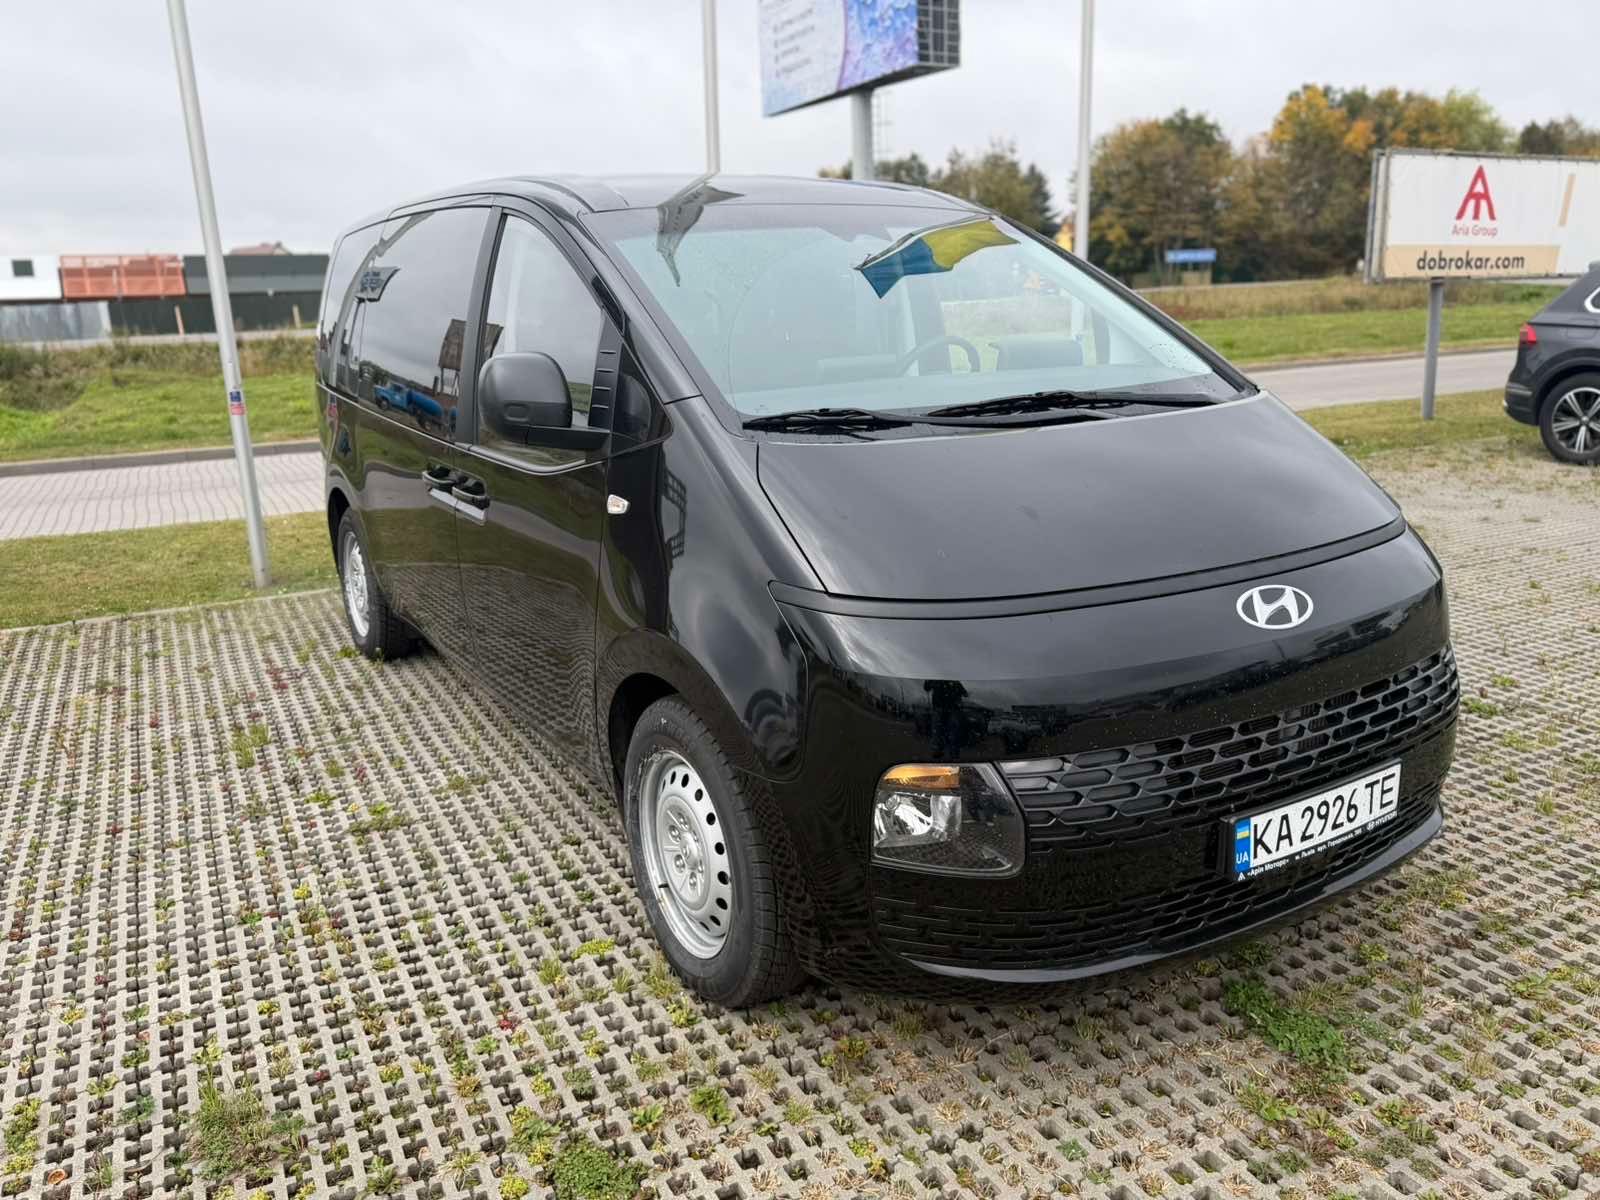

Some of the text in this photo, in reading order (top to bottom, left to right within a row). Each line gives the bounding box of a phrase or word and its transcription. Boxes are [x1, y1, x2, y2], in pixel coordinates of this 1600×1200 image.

[1471, 225, 1498, 238] Group
[1416, 250, 1525, 270] dobrokar.com
[1253, 773, 1396, 859] KA 2926 TE
[1236, 851, 1249, 864] UA
